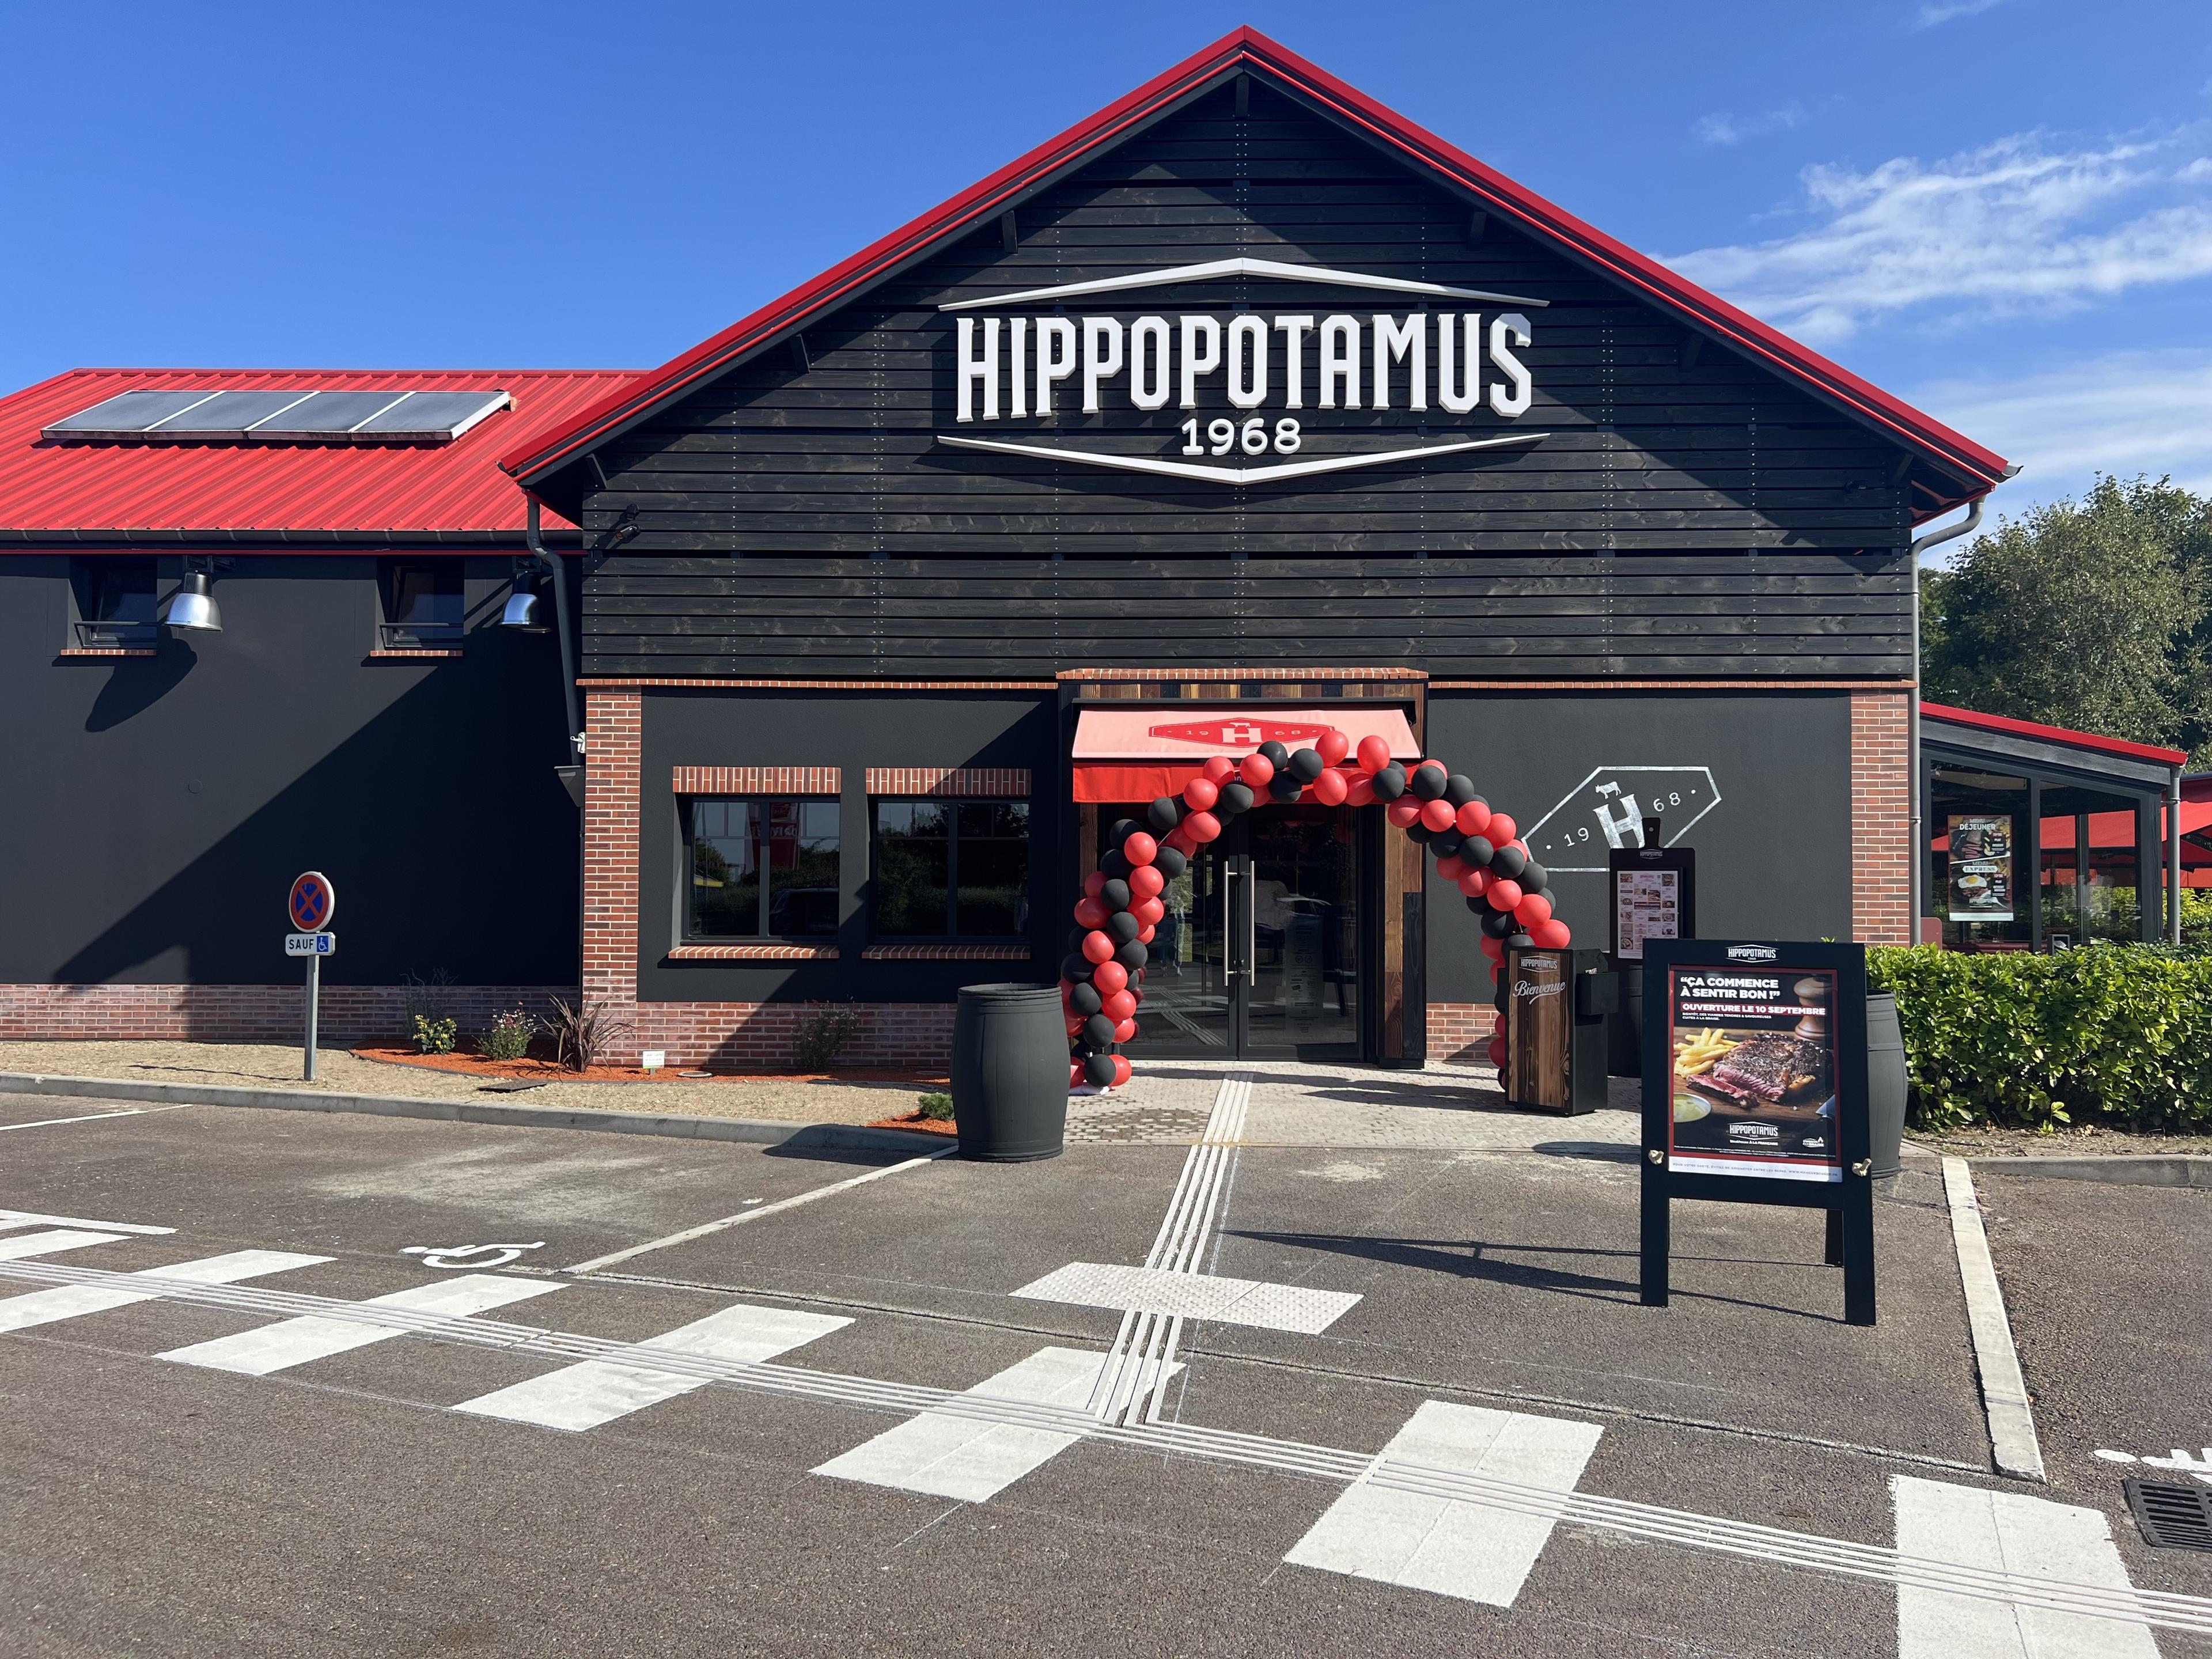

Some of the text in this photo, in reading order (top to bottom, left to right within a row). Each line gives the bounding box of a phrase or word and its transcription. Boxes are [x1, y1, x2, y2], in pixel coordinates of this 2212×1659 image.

[956, 313, 1532, 423] HIPPOPOTAMUS
[1181, 418, 1301, 456] 1968
[1221, 728, 1263, 743] H
[1592, 794, 1645, 849] H
[1959, 822, 1996, 830] DÉJEUNER
[289, 939, 315, 950] SAUF
[1728, 948, 1777, 959] HIPPOPOTAMUS
[1521, 958, 1558, 969] HIPPOPOTAMUS
[1707, 978, 1779, 988] COMMENCE
[1513, 980, 1566, 1004] Bienvenue
[1680, 986, 1691, 997] À
[1692, 988, 1738, 998] SENTIR
[1739, 990, 1767, 999] BON
[1682, 1003, 1741, 1012] OUVERTURE
[1768, 1006, 1826, 1016] SEPTEMBRE
[1729, 1124, 1779, 1137] HIPPOPOTAMUS
